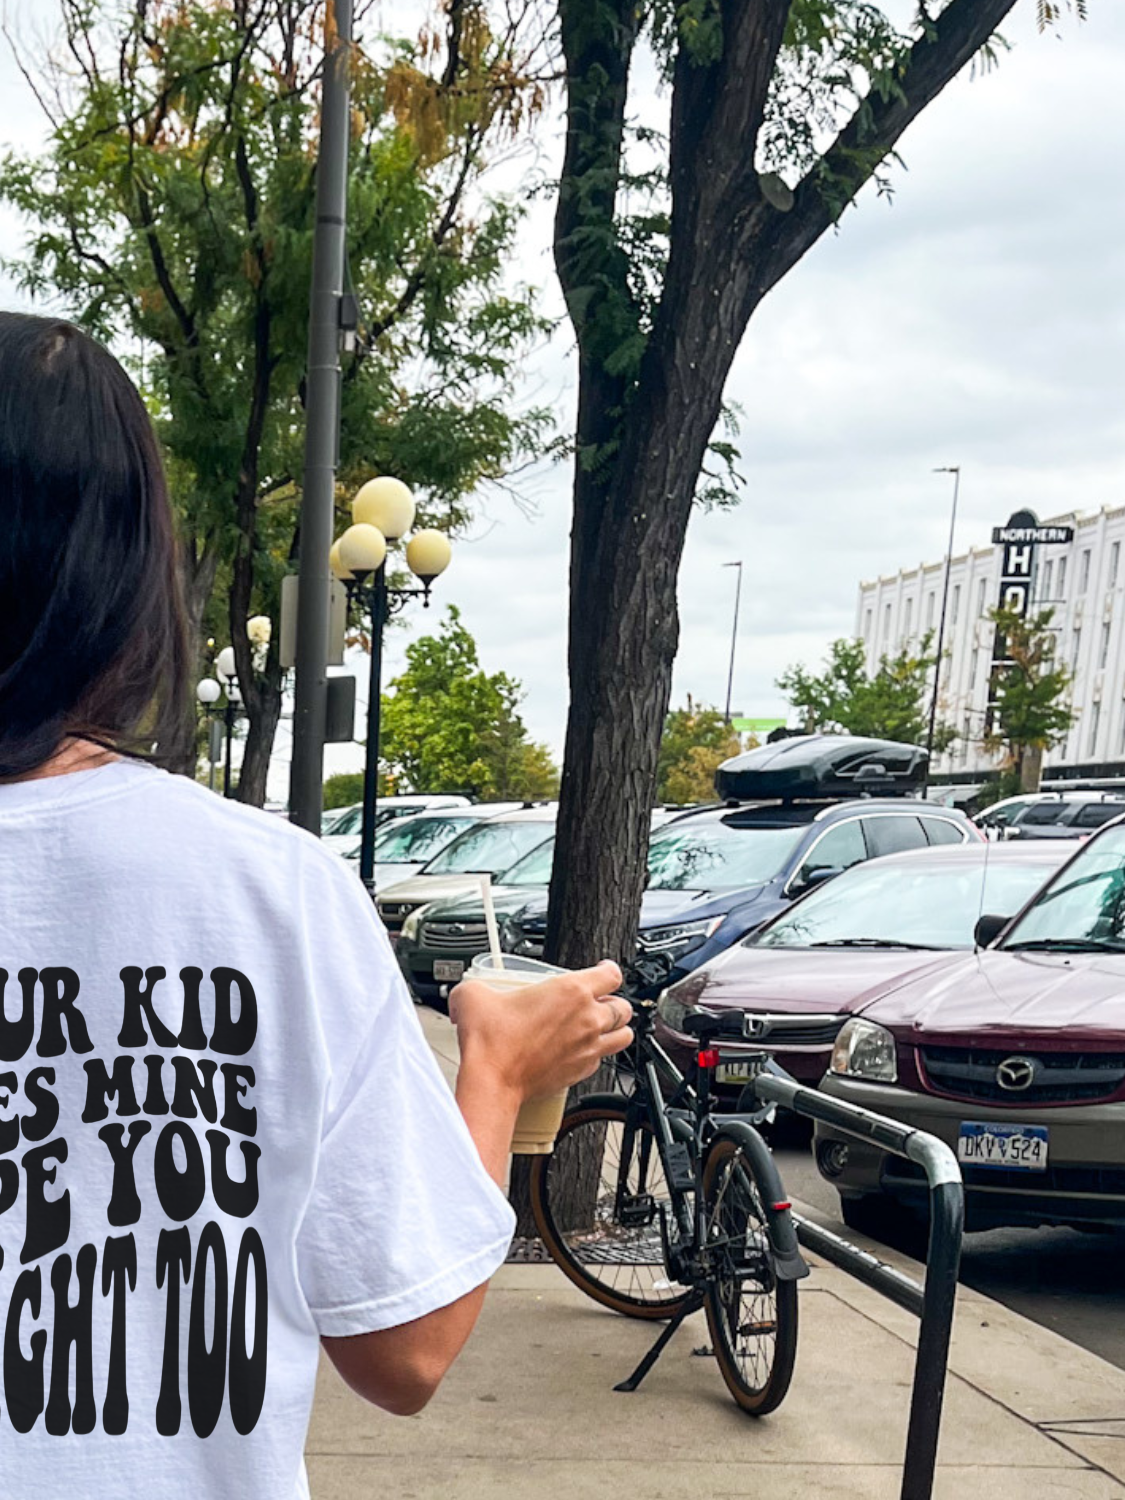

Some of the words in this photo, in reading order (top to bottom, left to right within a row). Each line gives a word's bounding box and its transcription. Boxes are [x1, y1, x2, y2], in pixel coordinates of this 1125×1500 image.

[999, 528, 1067, 541] NORTHERN
[117, 965, 258, 1055] KID
[81, 1054, 257, 1137] MINE
[98, 1119, 262, 1227] YOU
[1010, 1138, 1041, 1161] 524
[155, 1220, 268, 1438] TOO
